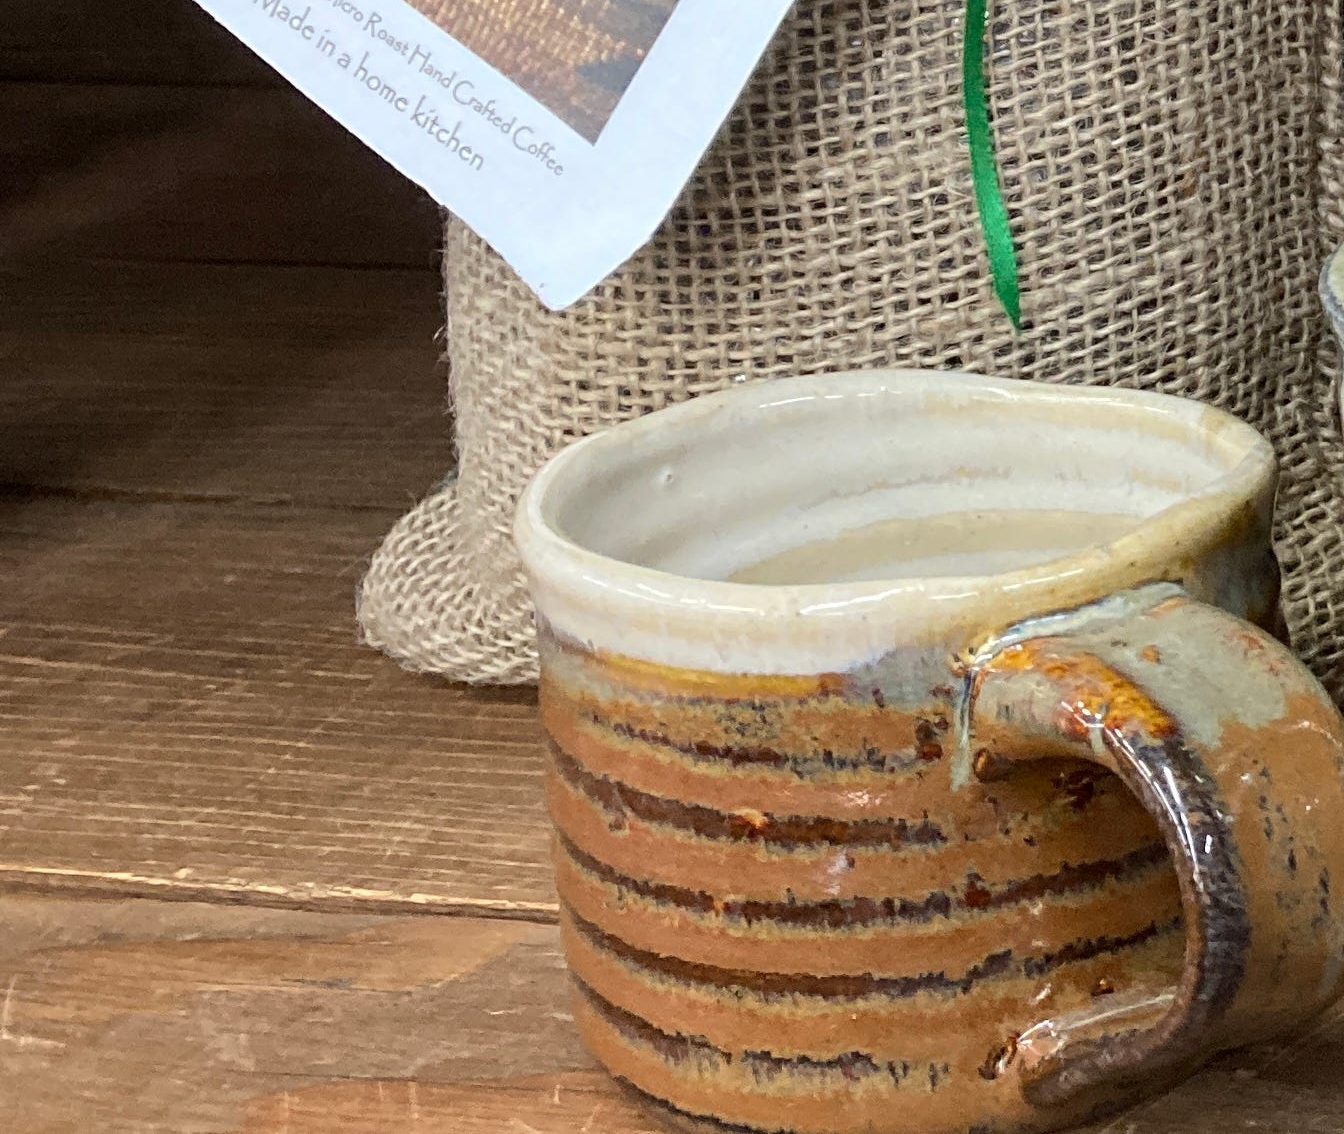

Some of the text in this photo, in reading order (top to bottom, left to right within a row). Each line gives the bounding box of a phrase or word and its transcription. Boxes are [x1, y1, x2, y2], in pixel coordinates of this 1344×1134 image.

[316, 28, 337, 58] in
[337, 52, 352, 69] a
[353, 51, 410, 113] home
[409, 94, 485, 172] kitchen
[363, 12, 410, 56] Roast
[408, 43, 456, 90] Hand
[452, 80, 517, 134] Crafted
[512, 125, 564, 177] Coffee
